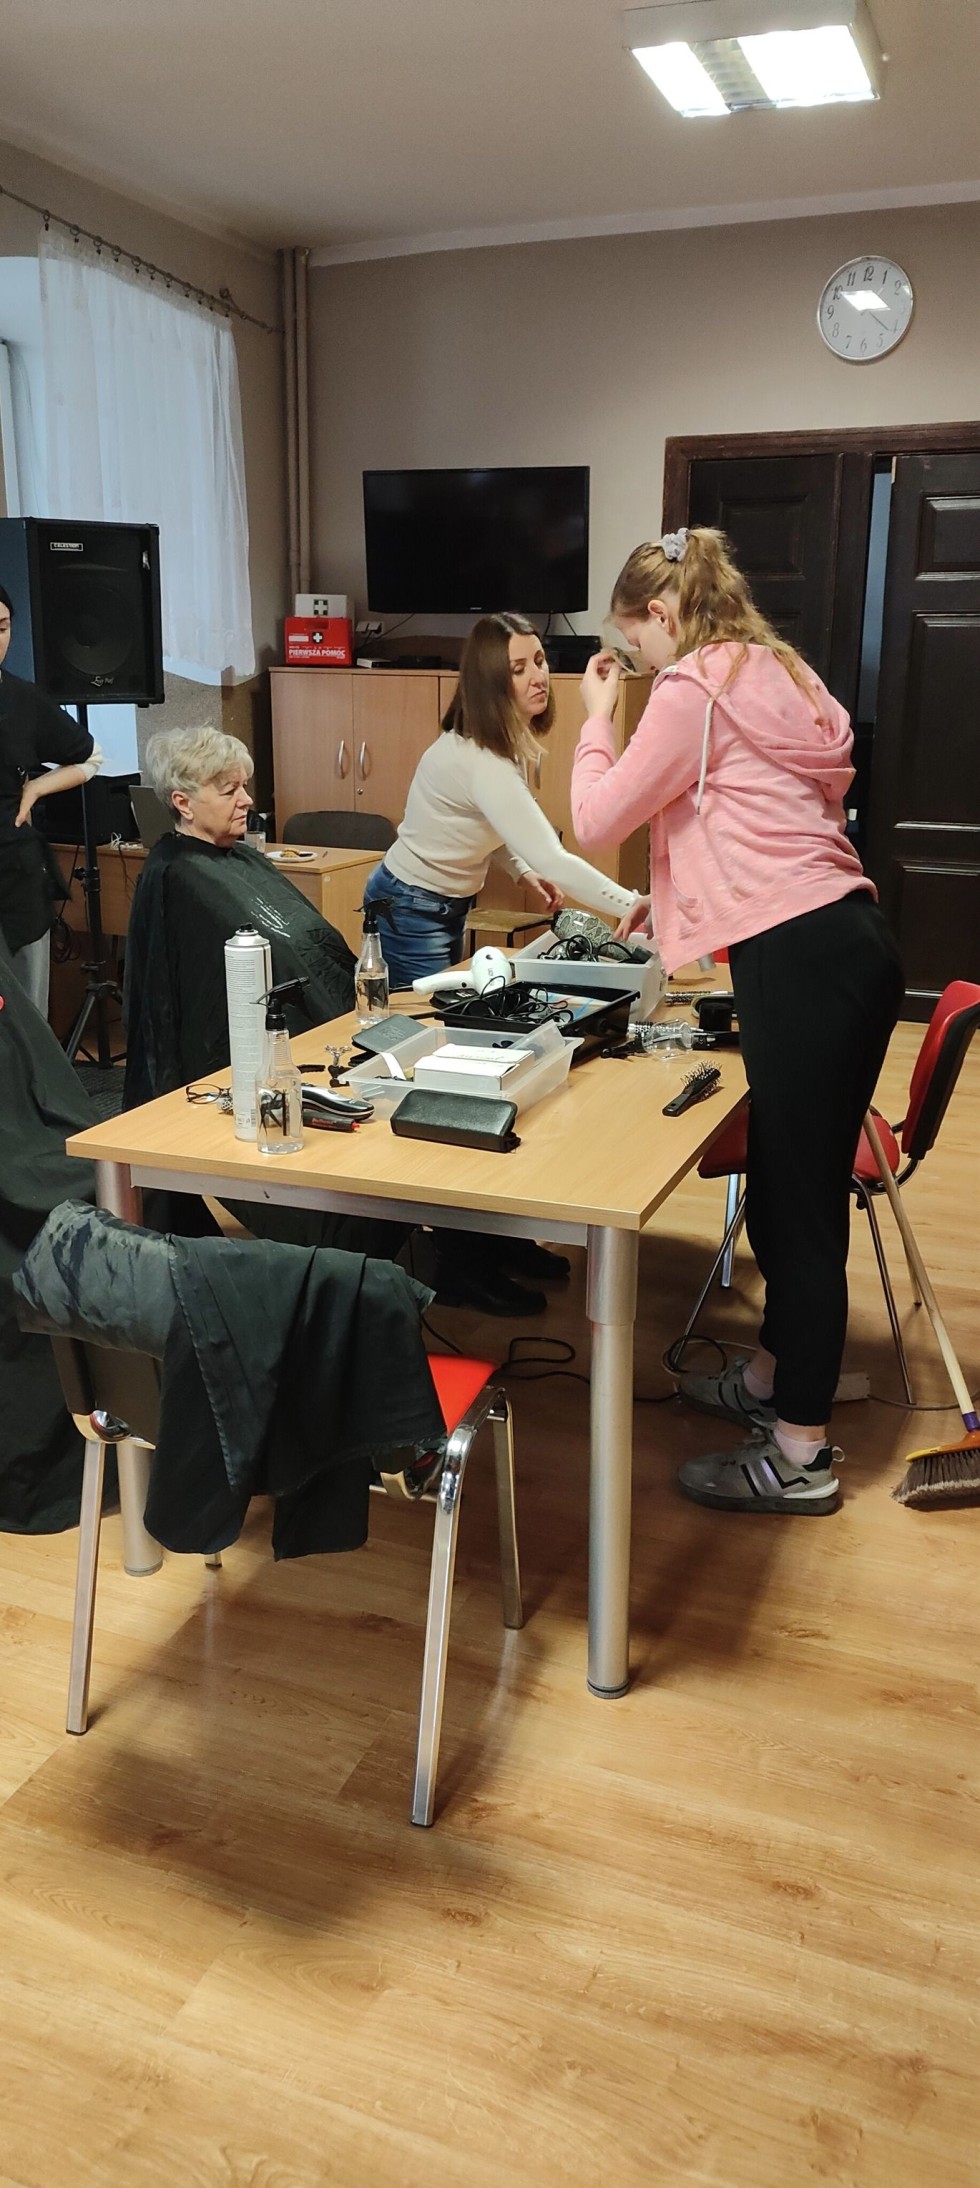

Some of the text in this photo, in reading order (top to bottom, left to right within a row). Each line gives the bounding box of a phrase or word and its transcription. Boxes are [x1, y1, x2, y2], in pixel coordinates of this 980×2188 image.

[846, 270, 856, 287] 11
[863, 265, 875, 282] 12
[882, 269, 888, 285] 1
[894, 279, 902, 296] 2
[827, 304, 835, 320] 9
[831, 321, 840, 338] 8
[845, 334, 853, 349] 7
[860, 337, 867, 353] 6
[876, 332, 884, 348] 5
[289, 649, 346, 657] PIERWSZA POMOC
